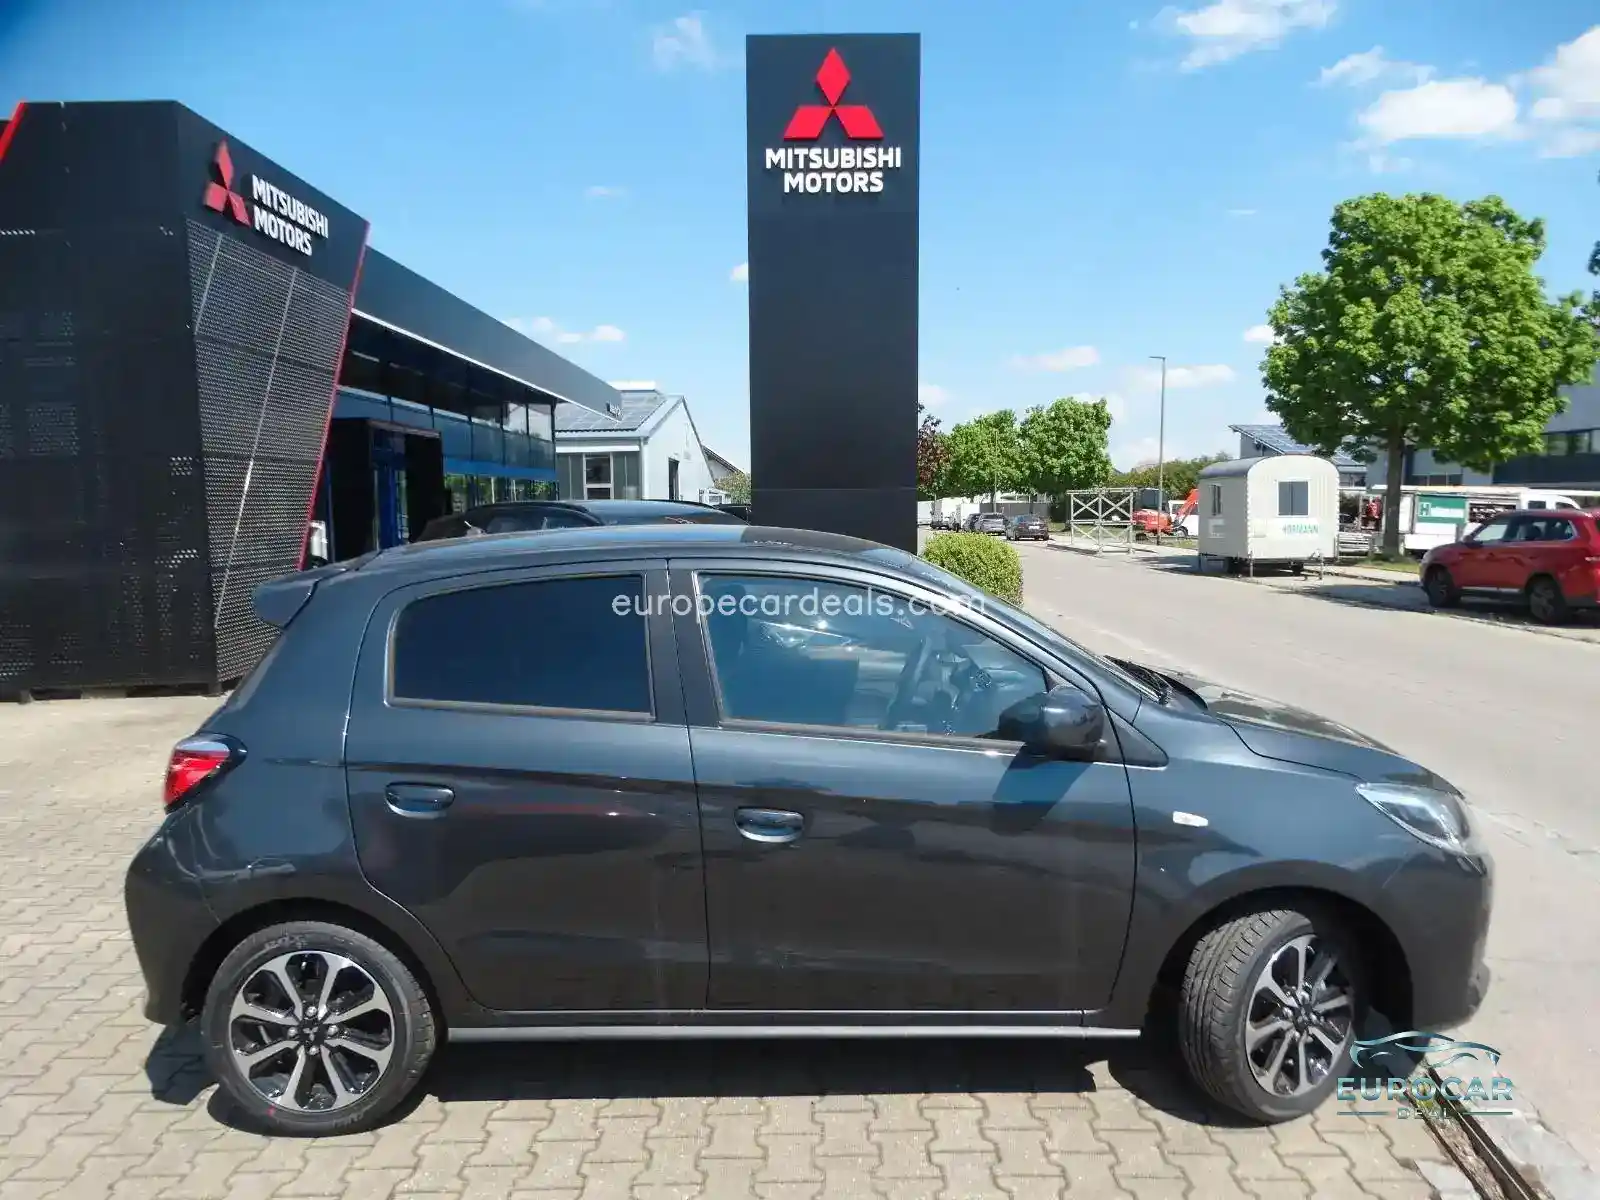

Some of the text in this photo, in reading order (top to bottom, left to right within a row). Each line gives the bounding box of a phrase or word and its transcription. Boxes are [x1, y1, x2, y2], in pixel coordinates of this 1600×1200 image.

[765, 147, 902, 169] MITSUBISHI
[783, 172, 884, 193] MOTORS
[252, 174, 329, 238] MITSUBISHI
[253, 204, 313, 256] MOTORS
